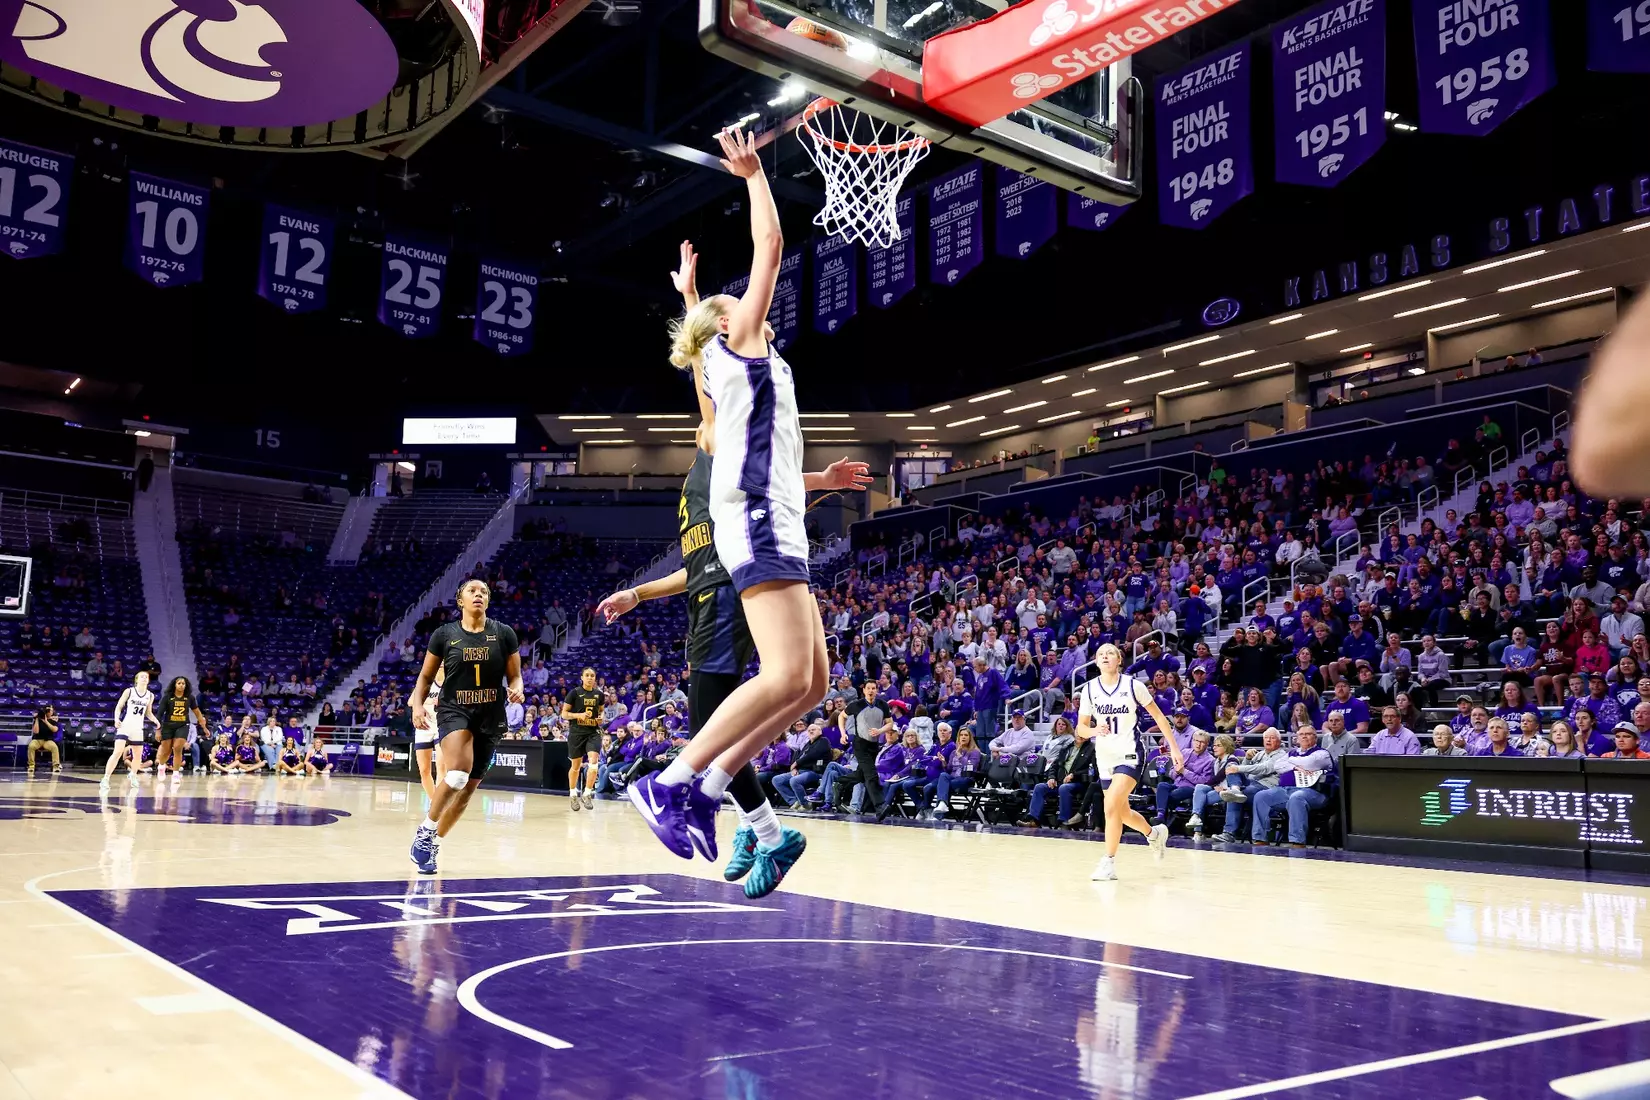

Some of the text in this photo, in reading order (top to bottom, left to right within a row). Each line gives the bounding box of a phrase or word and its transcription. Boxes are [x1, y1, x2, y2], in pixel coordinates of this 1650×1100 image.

[1281, 0, 1373, 49] K-STATE
[1288, 13, 1369, 55] MEN'S BASKETBALL
[1439, 4, 1520, 55] FOUR
[1052, 0, 1236, 77] StateFar
[1161, 51, 1242, 101] K-STATE
[1295, 45, 1363, 91] FINAL
[1435, 47, 1530, 106] 1958
[1167, 72, 1236, 106] MEN'S BASKETBALL
[1295, 68, 1362, 112] FOUR
[1172, 100, 1230, 140] FINAL
[1295, 106, 1368, 158] 1951
[1172, 120, 1229, 160] FOUR
[0, 147, 59, 172] KRUGER
[136, 180, 203, 206] WILLIAMS
[933, 168, 978, 199] K-STATE
[999, 180, 1023, 198] SWEET
[1169, 157, 1234, 203] 1948
[0, 166, 61, 228] 12
[1005, 195, 1023, 209] 2018
[279, 215, 319, 234] EVANS
[929, 199, 979, 227] SWEET SIXTEEN
[1005, 205, 1023, 219] 2023
[135, 200, 199, 255] 10
[1280, 173, 1650, 307] KANSAS STATE
[140, 255, 185, 272] 1972-76
[269, 231, 326, 285] 12
[385, 242, 447, 265] BLACKMAN
[823, 256, 843, 271] NCAA
[385, 259, 441, 309] 25
[481, 264, 537, 285] RICHMOND
[272, 283, 315, 299] 1974-78
[393, 309, 430, 325] 1977-81
[481, 281, 532, 329] 23
[488, 329, 523, 343] 1986-88
[254, 428, 281, 448] 15
[122, 471, 133, 480] 14
[462, 646, 490, 662] WEST
[473, 663, 481, 687] 1
[455, 688, 497, 705] VIRGINIA
[1095, 703, 1130, 715] Wildcats
[132, 706, 145, 716] 34
[172, 706, 186, 716] 22
[1105, 716, 1118, 735] 11
[1475, 787, 1634, 823] INTRUST
